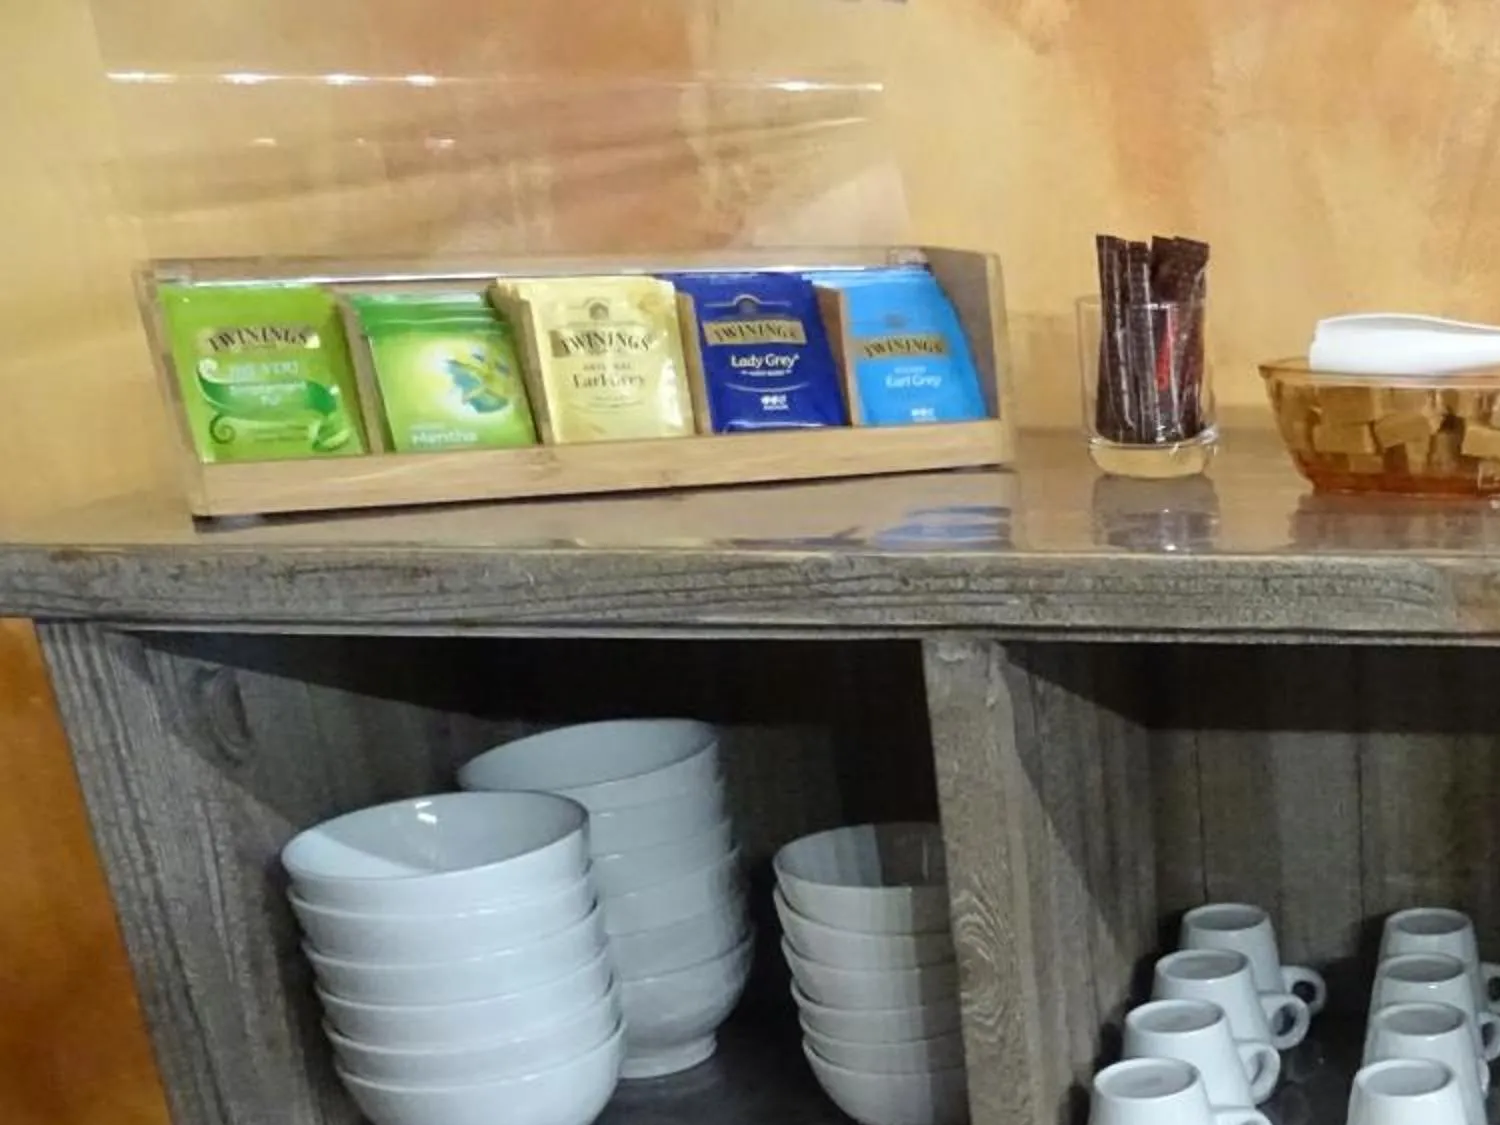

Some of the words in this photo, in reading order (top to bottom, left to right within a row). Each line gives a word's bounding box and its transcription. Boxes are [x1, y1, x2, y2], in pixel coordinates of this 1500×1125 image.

[208, 326, 309, 351] TWININGS
[560, 330, 649, 354] TWININGS
[713, 320, 798, 342] TWININGS
[864, 336, 944, 358] TWININGS
[731, 354, 763, 369] Lady
